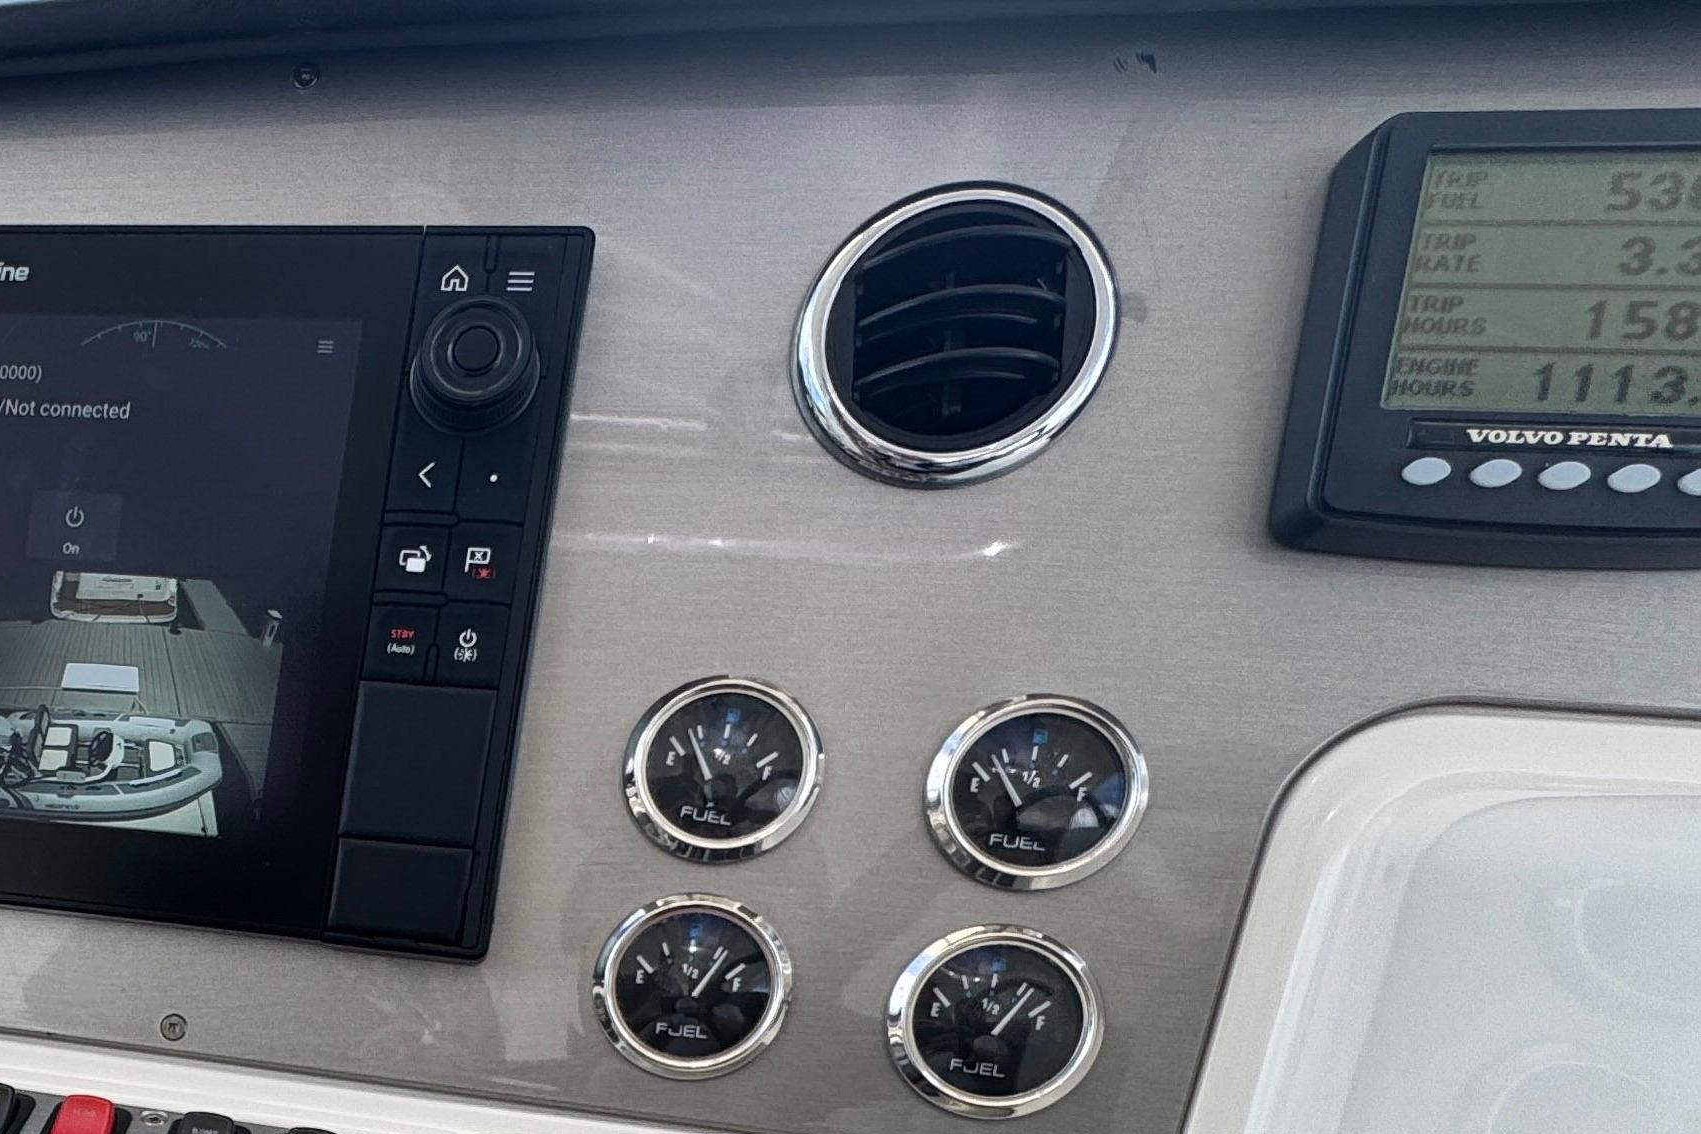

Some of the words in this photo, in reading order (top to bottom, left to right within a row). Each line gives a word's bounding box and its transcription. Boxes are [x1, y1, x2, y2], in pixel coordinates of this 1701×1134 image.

[1427, 193, 1484, 210] FUEL
[1421, 233, 1476, 250] TRIP
[1414, 254, 1480, 273] RATE
[1410, 295, 1464, 312] TRIP
[1403, 317, 1486, 335] HOURS
[1397, 358, 1479, 377] ENGINE
[1391, 378, 1475, 397] HOURS
[40, 401, 131, 419] connected
[1467, 428, 1564, 446] VOLVO
[1569, 430, 1674, 449] PENTA
[63, 542, 79, 555] On
[391, 629, 415, 639] STBY
[666, 751, 676, 766] E
[970, 777, 980, 793] E
[1077, 787, 1087, 802] F
[680, 805, 731, 826] FUEL
[989, 833, 1046, 852] FUEL
[635, 969, 645, 984] E
[732, 977, 742, 993] F
[930, 1002, 940, 1017] E
[655, 1022, 707, 1039] FUEL
[1035, 1015, 1046, 1031] F
[949, 1058, 1006, 1078] FUEL
